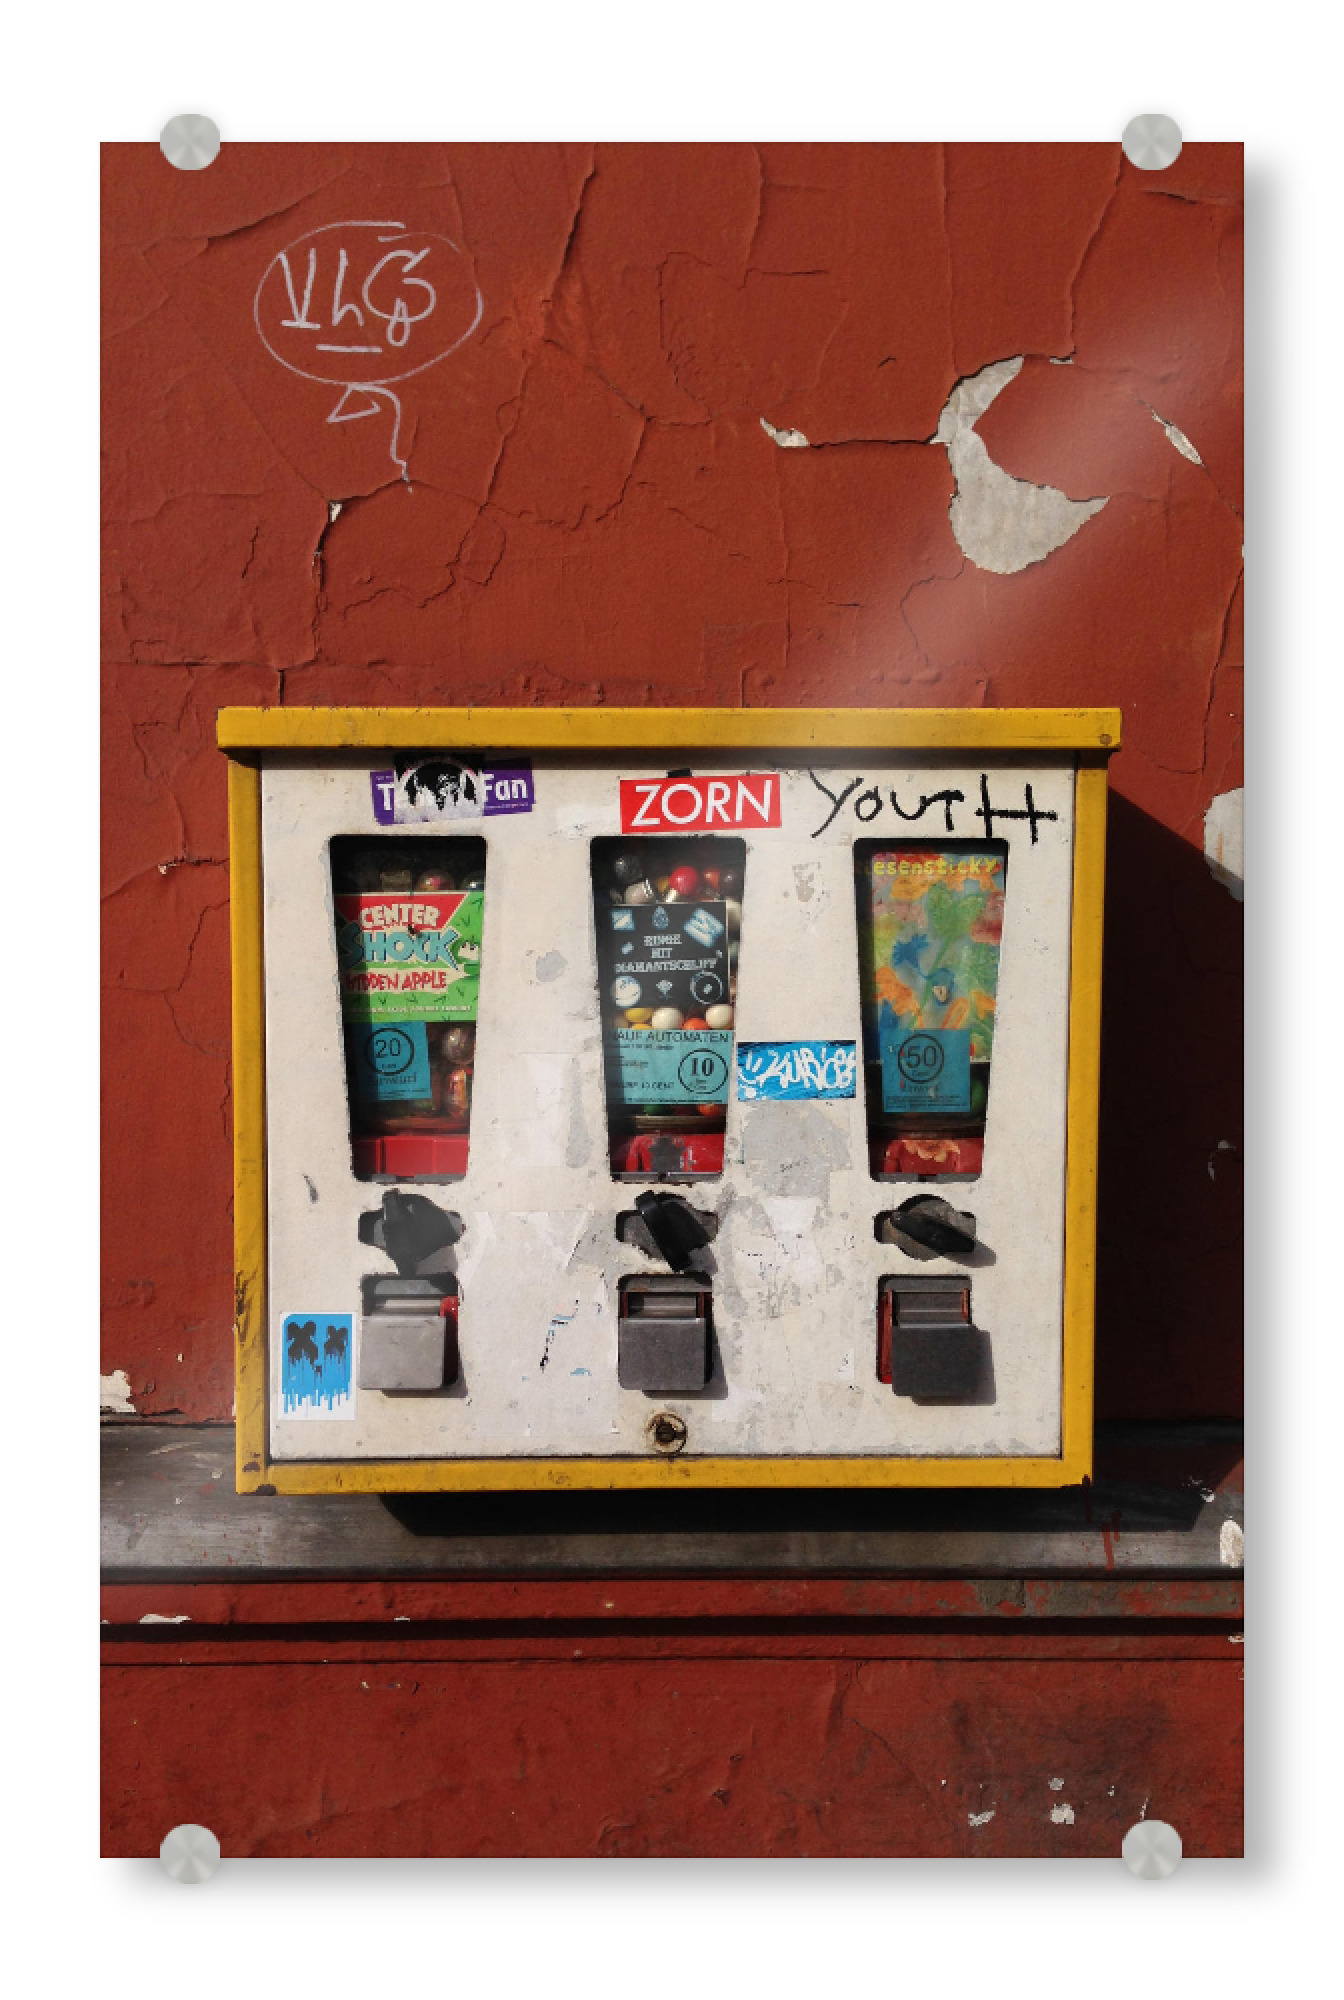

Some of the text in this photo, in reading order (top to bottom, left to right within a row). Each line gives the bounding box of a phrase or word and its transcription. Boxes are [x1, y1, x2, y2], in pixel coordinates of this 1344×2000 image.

[630, 779, 773, 827] ZORN
[361, 903, 441, 928] CENTER
[339, 922, 462, 972] SHOCK
[401, 970, 447, 991] APPLE
[375, 1037, 401, 1059] 20
[646, 1031, 729, 1043] AUTOMATEN
[691, 1057, 715, 1077] 10
[905, 1045, 937, 1069] 50
